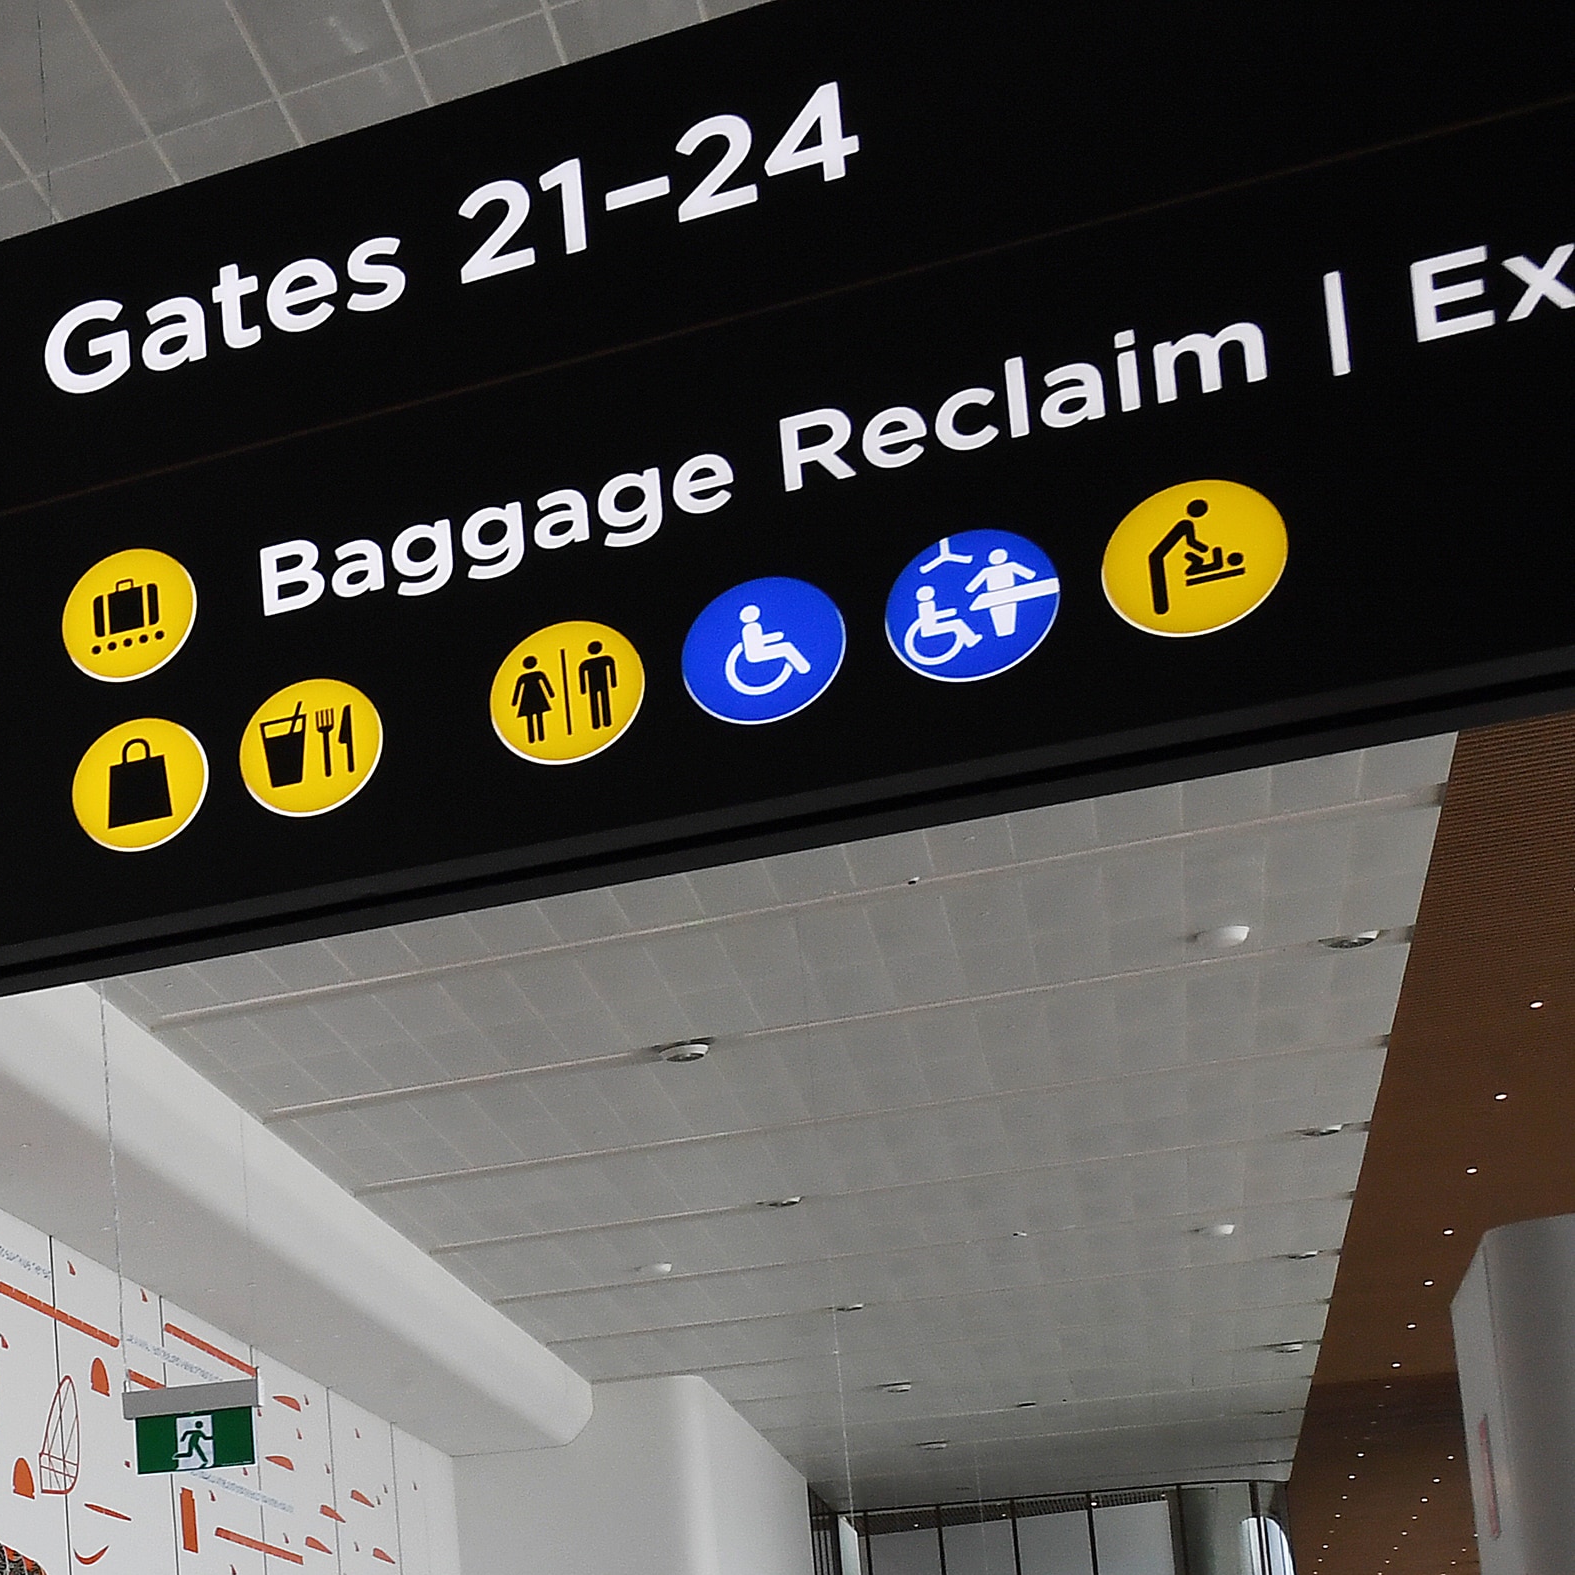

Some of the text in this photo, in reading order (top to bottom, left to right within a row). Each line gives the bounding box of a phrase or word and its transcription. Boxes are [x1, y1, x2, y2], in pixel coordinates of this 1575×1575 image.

[45, 236, 406, 394] Gates
[259, 453, 734, 617] Baggage
[779, 322, 1268, 492] Reclaim
[1410, 243, 1575, 343] Ex
